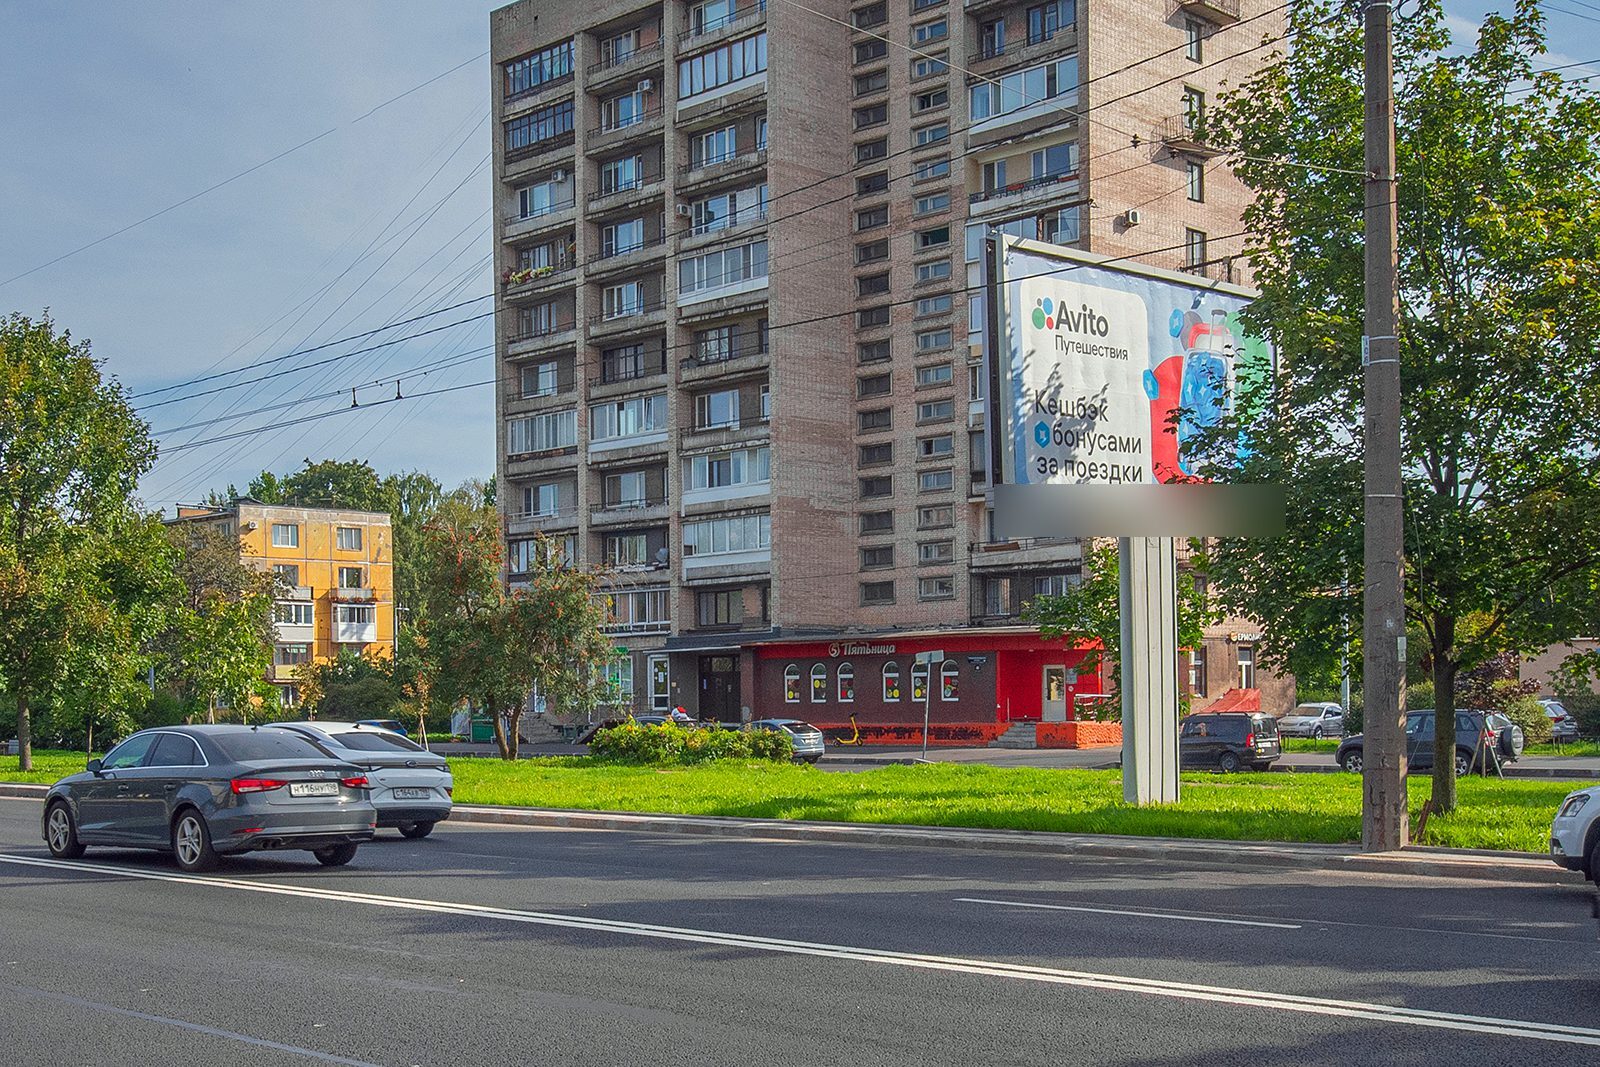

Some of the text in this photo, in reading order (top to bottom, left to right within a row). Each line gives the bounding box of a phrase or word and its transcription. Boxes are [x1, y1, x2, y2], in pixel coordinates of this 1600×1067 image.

[1055, 300, 1109, 337] Avito
[1055, 334, 1129, 360] Путешествия
[1035, 389, 1109, 422] Кешбэк
[1052, 422, 1142, 456] бонусами
[1036, 456, 1142, 484] за поездки
